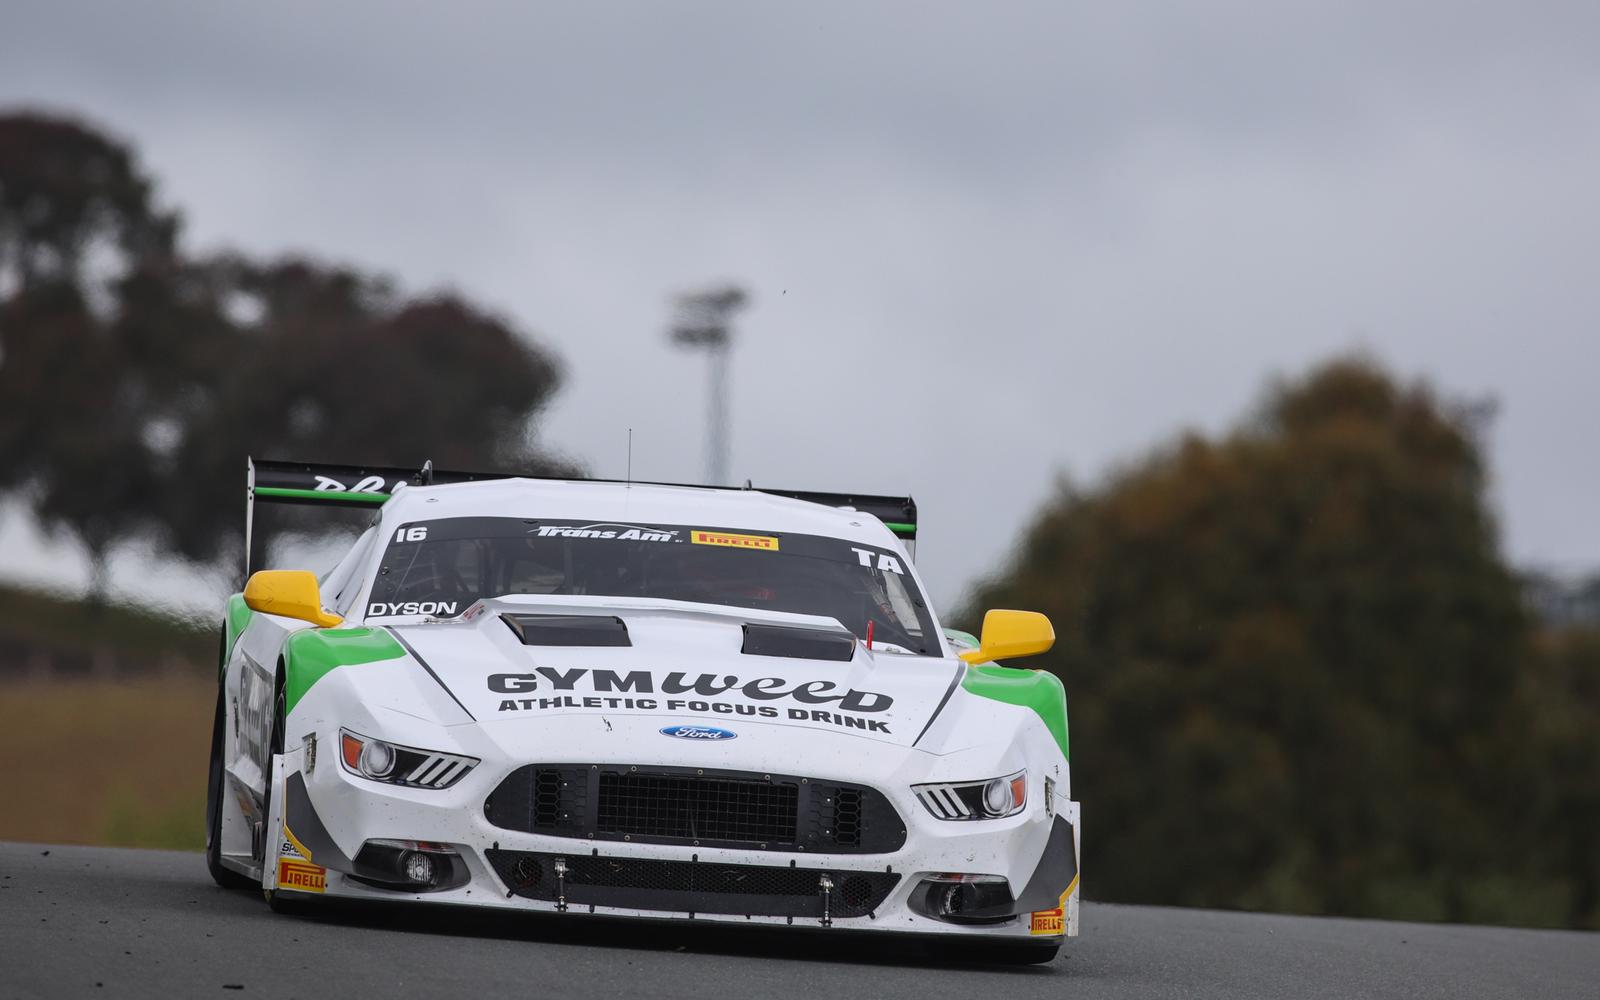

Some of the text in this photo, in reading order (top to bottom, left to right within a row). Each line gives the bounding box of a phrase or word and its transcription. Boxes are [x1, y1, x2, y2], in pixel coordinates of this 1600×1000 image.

[396, 527, 428, 543] 16
[537, 525, 672, 542] Trans Am
[699, 533, 770, 549] PIRELLI
[851, 547, 905, 575] TA
[368, 601, 458, 616] DYSON
[498, 696, 892, 734] ATHLETIC FOCUS DRINK
[674, 726, 723, 739] Ford
[280, 862, 326, 889] PIRELLI
